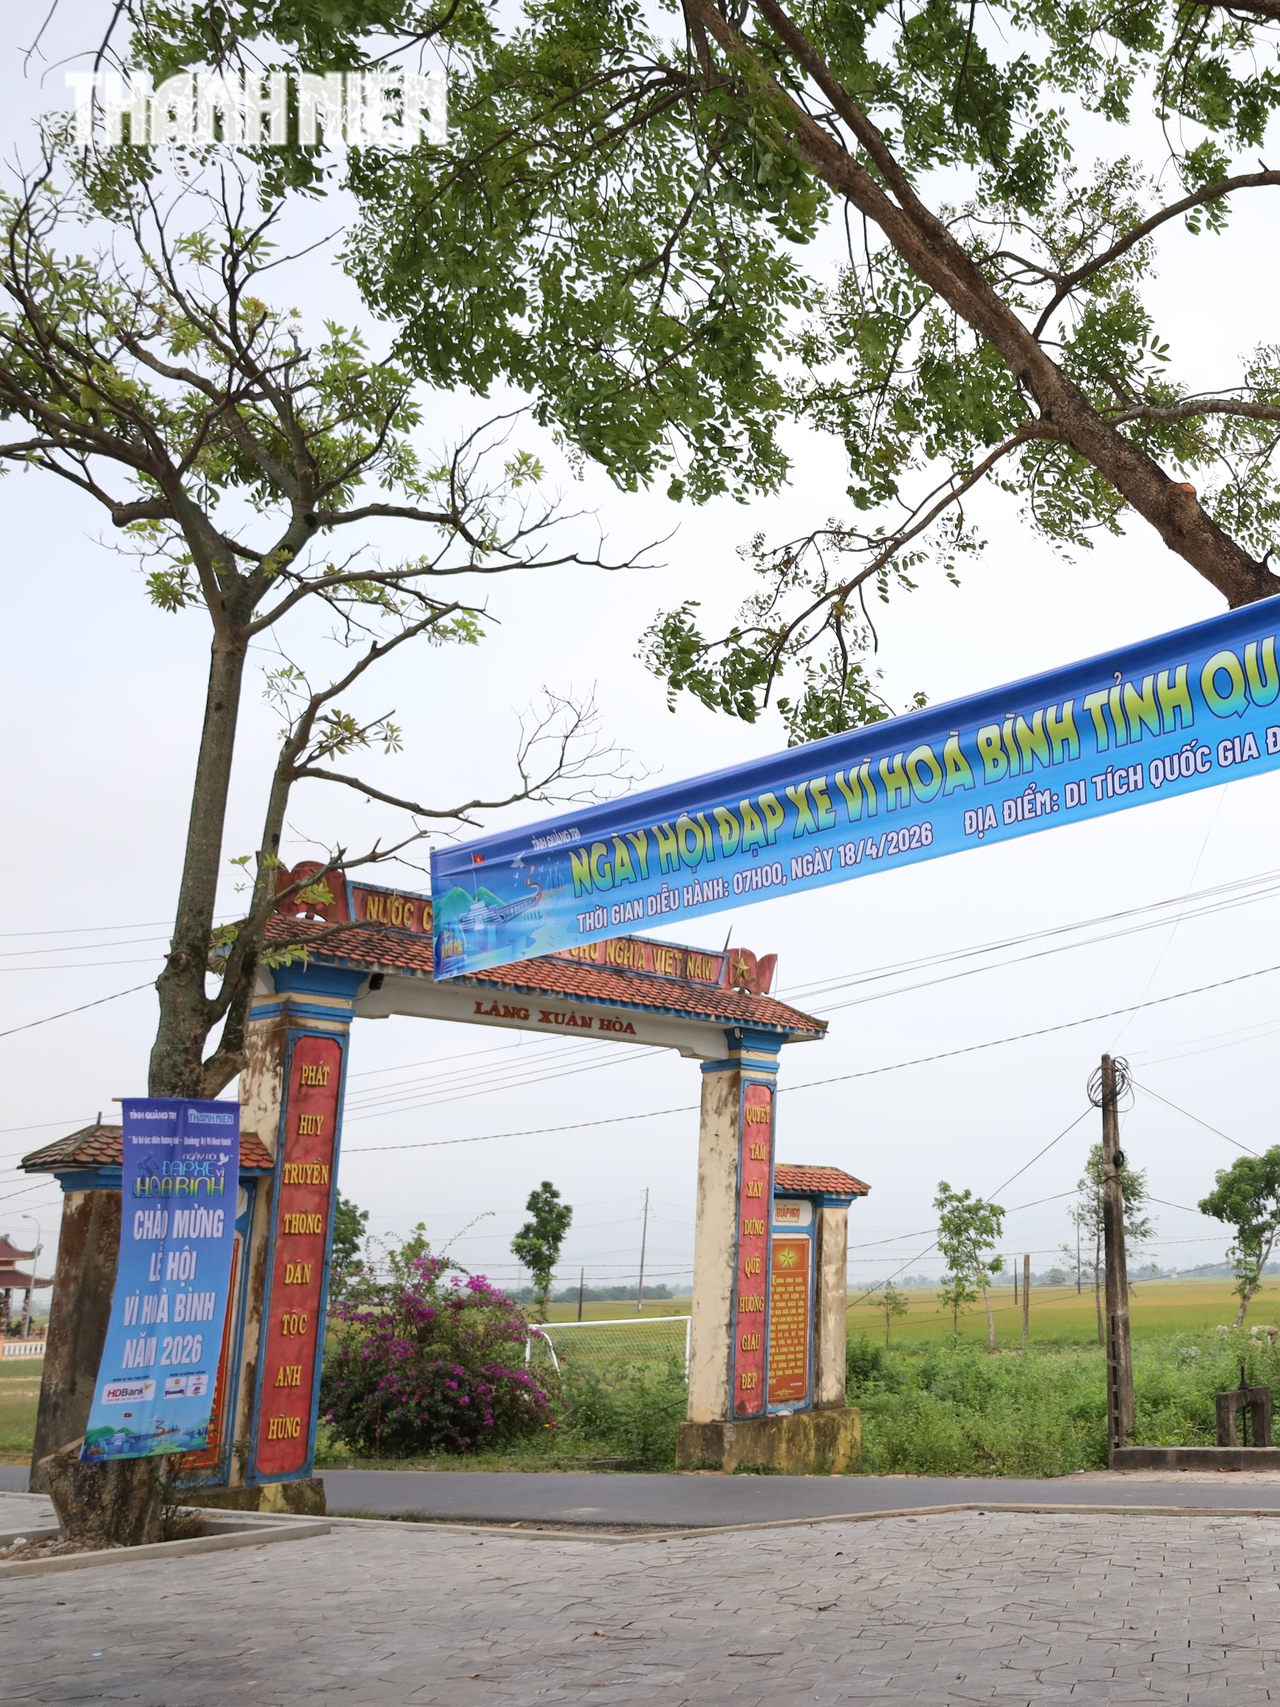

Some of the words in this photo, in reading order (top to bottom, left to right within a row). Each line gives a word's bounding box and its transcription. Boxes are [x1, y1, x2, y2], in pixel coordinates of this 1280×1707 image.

[569, 829, 650, 898] NGÀY
[651, 811, 715, 875] HỘI
[713, 791, 785, 858] ĐẠP
[785, 774, 837, 839] XE
[834, 757, 878, 823] VÌ
[879, 731, 976, 813] HOÀ
[976, 700, 1080, 784] BÌNH
[1083, 663, 1194, 754] TỈNH
[577, 904, 608, 933] THỜI
[611, 898, 644, 926] GIAN
[647, 883, 679, 917] DIỄU
[683, 876, 729, 908] HÀNH:
[791, 846, 834, 880] NGÀY
[838, 821, 933, 868] 18/4/2026
[963, 804, 998, 839] ĐỊA
[1002, 783, 1060, 827] ĐIỂM:
[1064, 779, 1086, 809] DI
[1091, 764, 1143, 801] TÍCH
[1149, 739, 1212, 788] QUỐC
[1217, 732, 1259, 767] GIA
[366, 895, 414, 928] NƯỚC
[605, 940, 645, 969] NGHĨA
[652, 948, 682, 976] VIỆT
[686, 954, 713, 980] NAM
[474, 1000, 530, 1020] LÀNG
[538, 1010, 594, 1029] XUÂN
[598, 1016, 636, 1035] HÒA
[301, 1061, 330, 1086] PHÁT
[299, 1114, 324, 1136] HUY
[750, 1141, 766, 1160] TÂM
[162, 1161, 194, 1176] ĐẠP
[195, 1161, 217, 1176] XE
[283, 1157, 329, 1184] TRUYỀN
[175, 1176, 225, 1197] BÌNH
[747, 1178, 763, 1198] XÂY
[133, 1204, 168, 1240] CHÀO
[172, 1204, 225, 1239] MỪNG
[284, 1208, 323, 1234] THỐNG
[166, 1245, 198, 1287] HỘI
[285, 1259, 312, 1285] DÂN
[745, 1254, 761, 1278] QUÊ
[124, 1290, 140, 1326] VÌ
[141, 1287, 169, 1325] HOÀ
[174, 1286, 217, 1323] BÌNH
[282, 1310, 308, 1338] TỘC
[121, 1332, 158, 1369] NĂM
[160, 1334, 203, 1366] 2026
[741, 1331, 761, 1351] GIÀU
[275, 1366, 302, 1387] ANH
[741, 1373, 757, 1394] ĐẸP
[107, 1388, 145, 1398] HDBank
[267, 1414, 301, 1440] HÙNG
